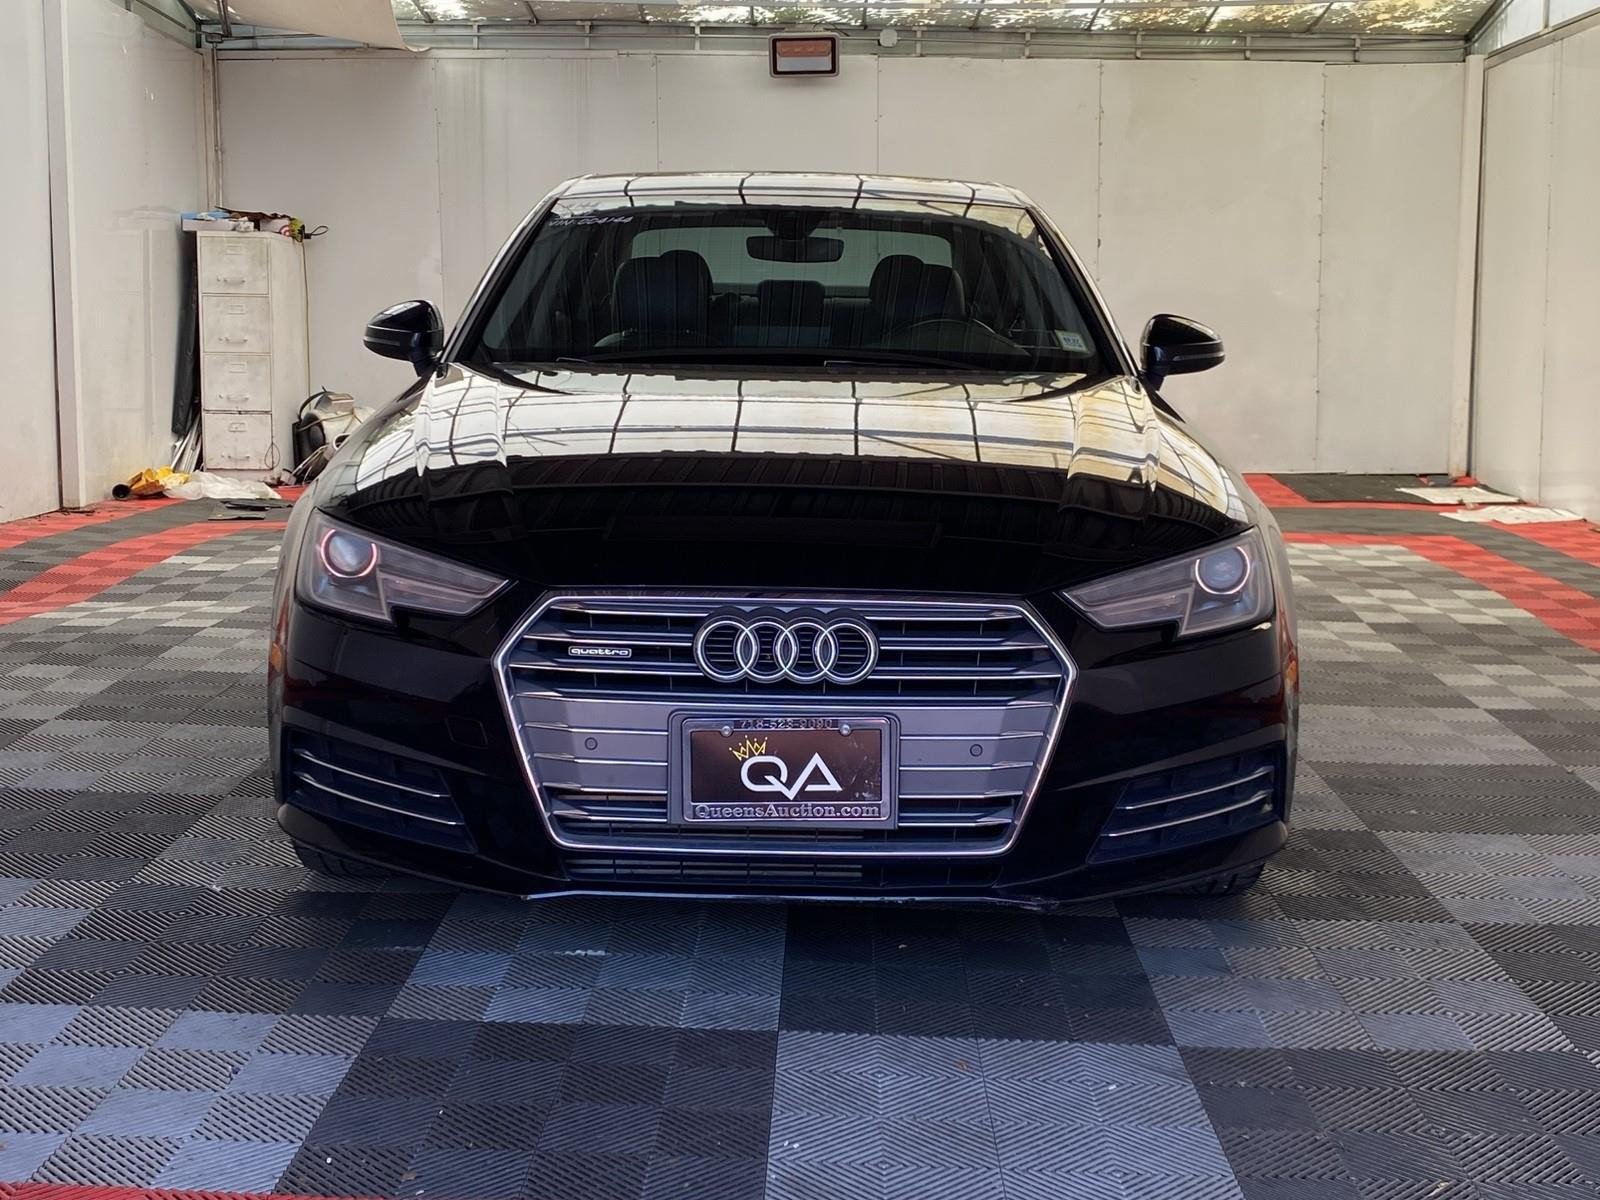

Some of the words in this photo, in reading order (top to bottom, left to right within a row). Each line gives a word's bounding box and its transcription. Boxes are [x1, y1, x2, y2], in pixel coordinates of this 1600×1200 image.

[571, 648, 629, 656] quattro
[740, 751, 843, 801] QA
[695, 803, 879, 819] QueensAuction.com
